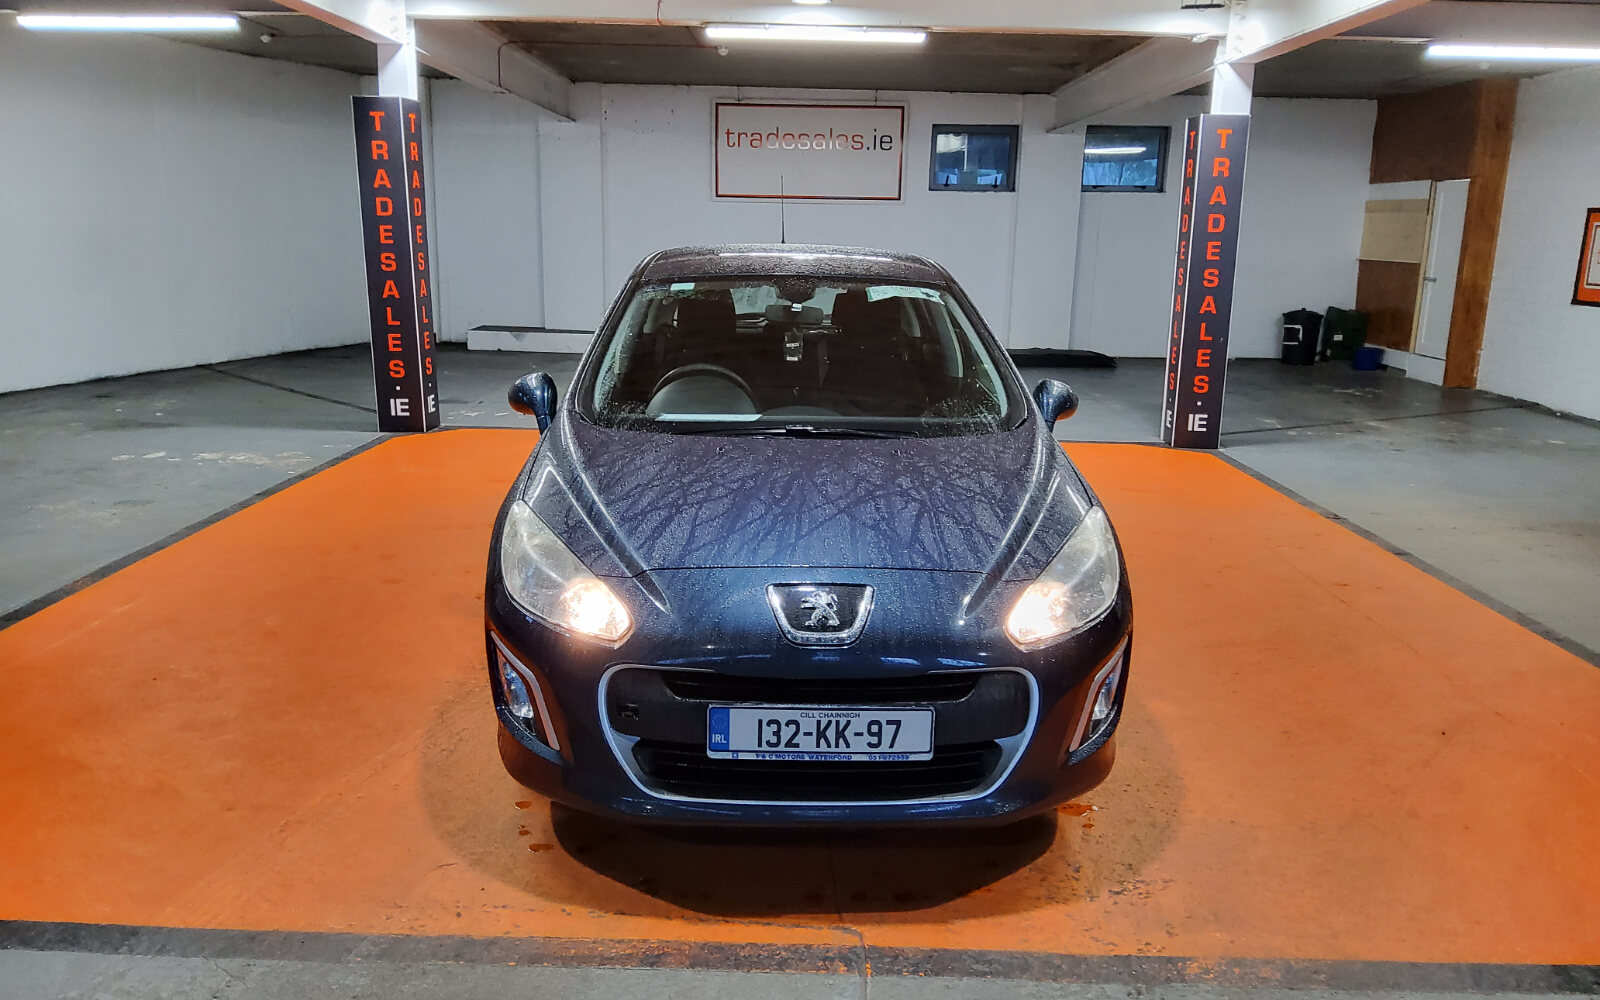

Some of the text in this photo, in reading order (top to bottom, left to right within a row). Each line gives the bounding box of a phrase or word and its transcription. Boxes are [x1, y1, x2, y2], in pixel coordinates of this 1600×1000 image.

[725, 127, 893, 151] tradesales.ie
[712, 733, 727, 743] IRL
[757, 718, 902, 749] 132-KK-97
